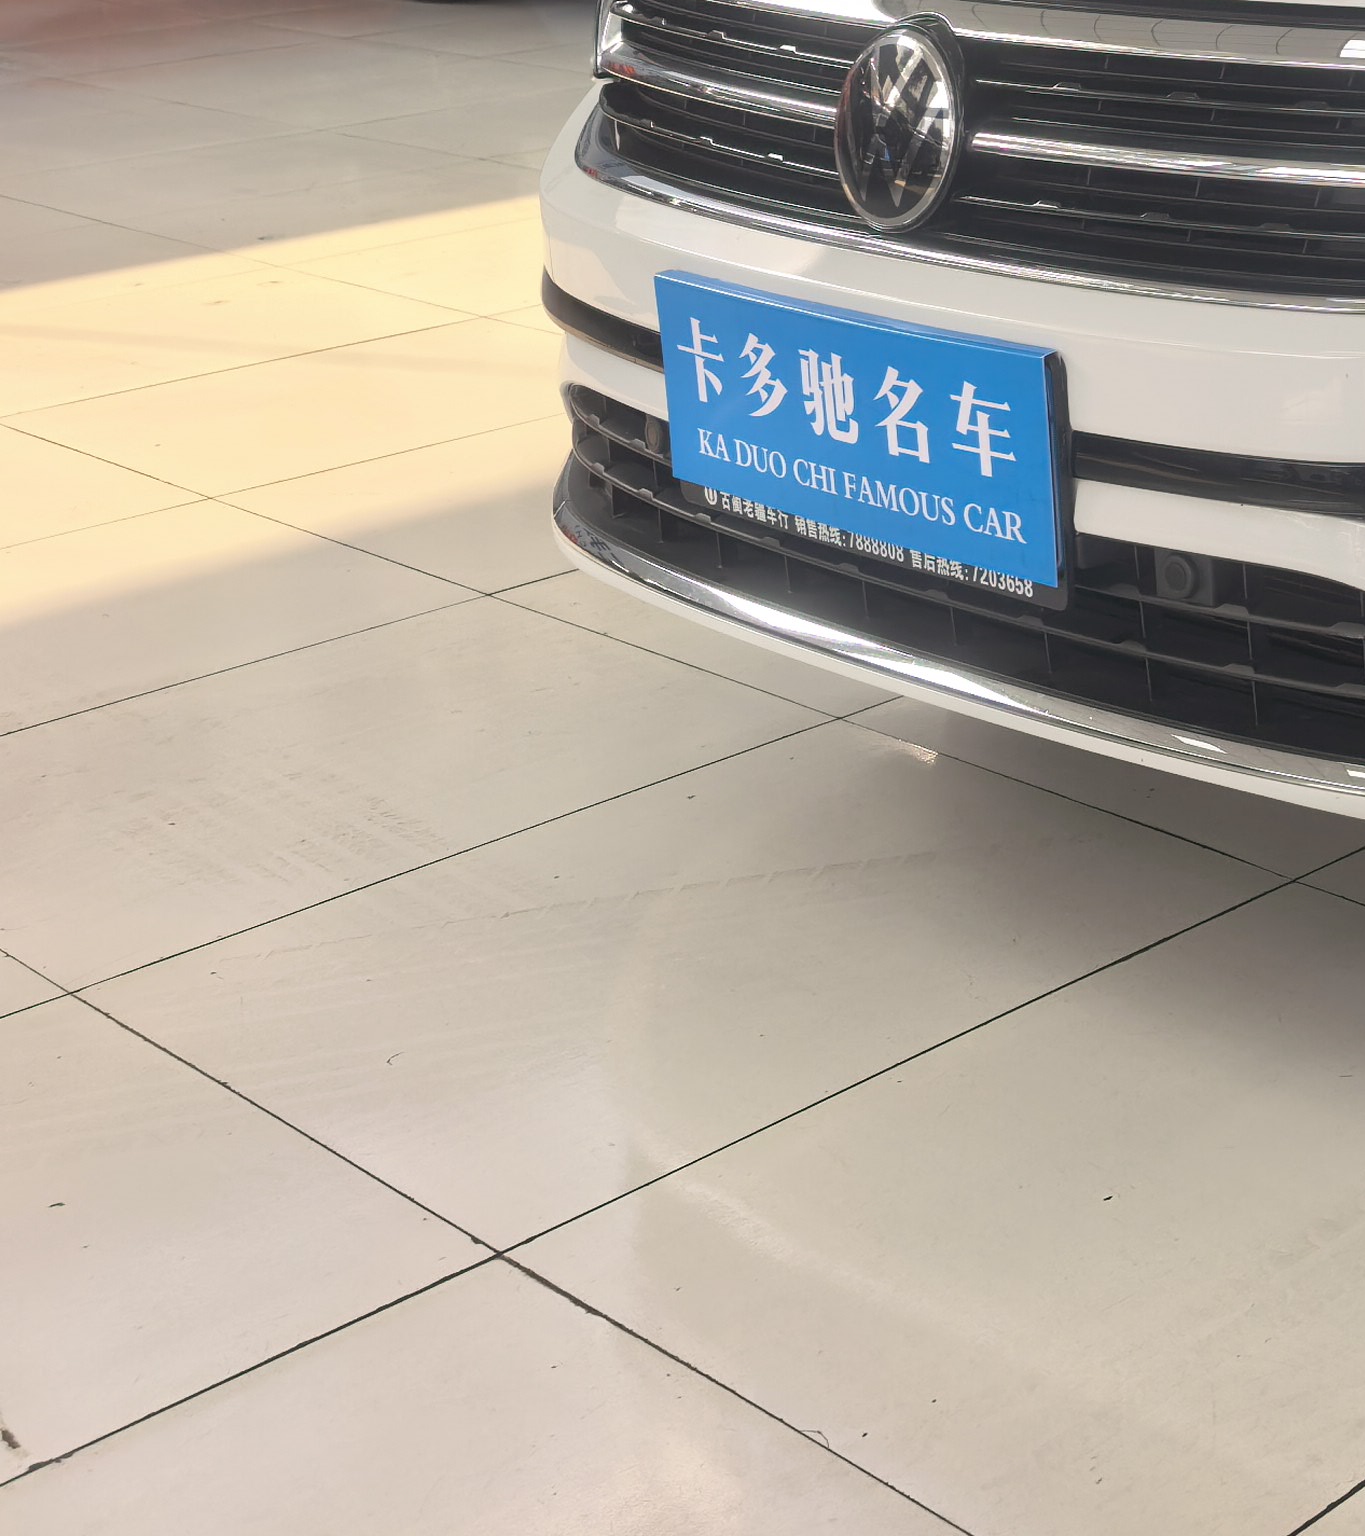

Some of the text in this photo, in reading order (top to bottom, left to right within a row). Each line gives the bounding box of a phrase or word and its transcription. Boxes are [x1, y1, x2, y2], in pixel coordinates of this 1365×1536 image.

[677, 316, 1017, 478] 卡多驰名车
[698, 427, 1027, 544] KA DUO CHI FAMOUS CAR
